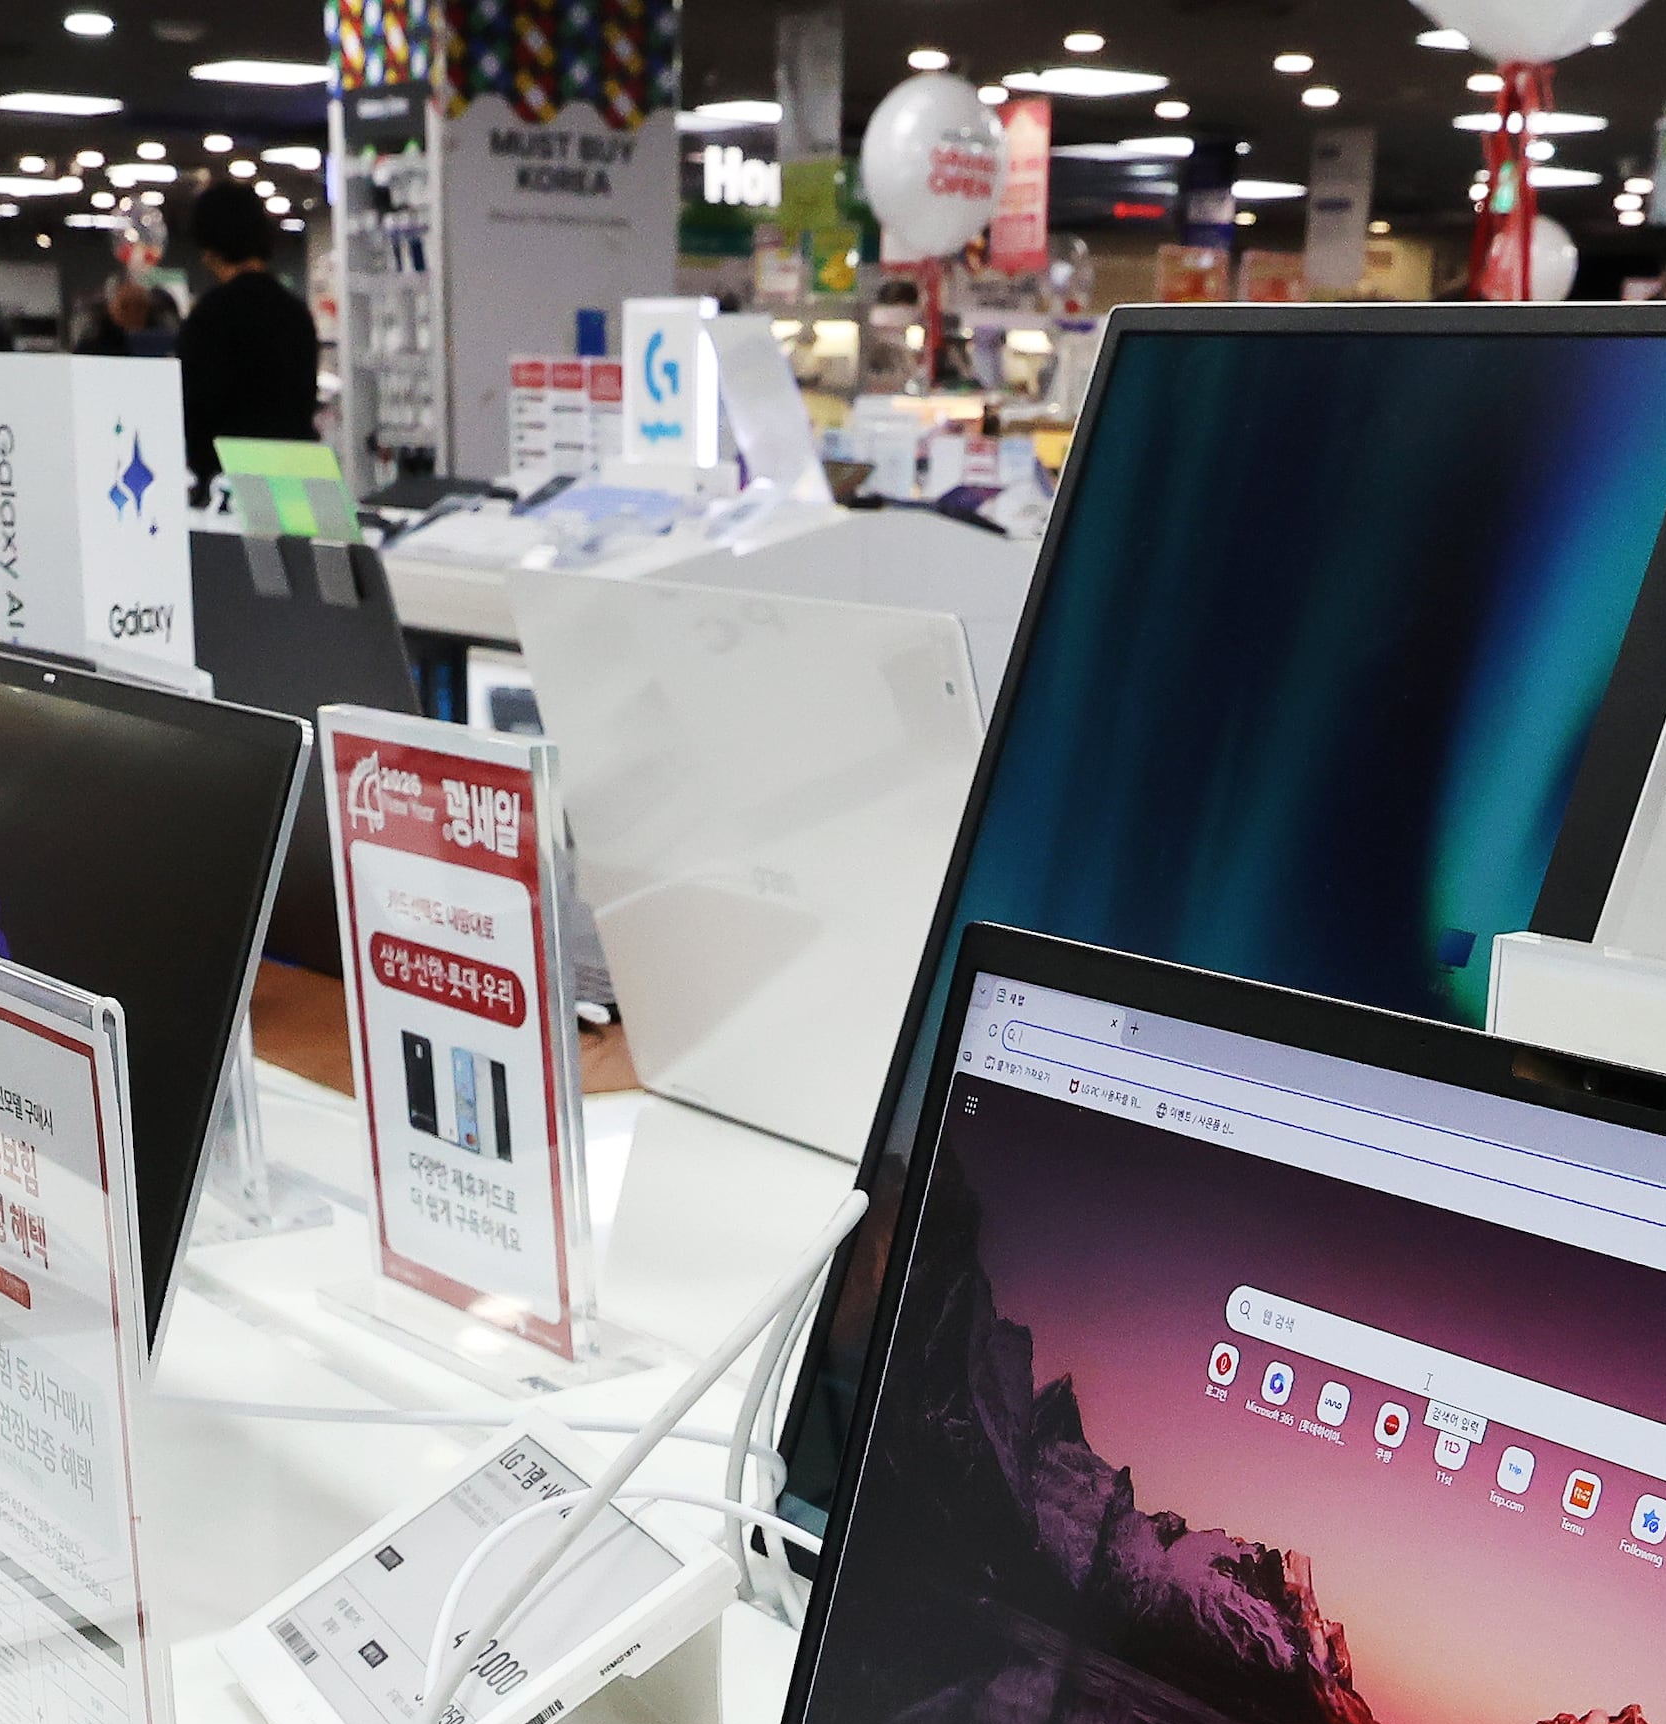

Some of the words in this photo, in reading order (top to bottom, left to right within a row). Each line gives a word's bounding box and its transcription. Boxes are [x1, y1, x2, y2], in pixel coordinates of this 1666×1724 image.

[4, 590, 25, 629] AI
[108, 601, 175, 643] Galaxy
[440, 777, 521, 859] 광세일
[9, 1201, 50, 1271] 혜택
[1262, 1308, 1273, 1327] 웹
[1275, 1313, 1296, 1333] 검색
[1244, 1399, 1279, 1421] Microsoft
[1278, 1411, 1295, 1427] 365
[1431, 1406, 1460, 1429] 검색어
[1460, 1416, 1480, 1436] 입력
[498, 1448, 526, 1471] LG
[1374, 1447, 1393, 1464] 쿠팡
[60, 1442, 95, 1504] 혜택
[1488, 1489, 1526, 1514] Trip.com
[1559, 1516, 1586, 1537] Temu
[1618, 1539, 1665, 1569] Following
